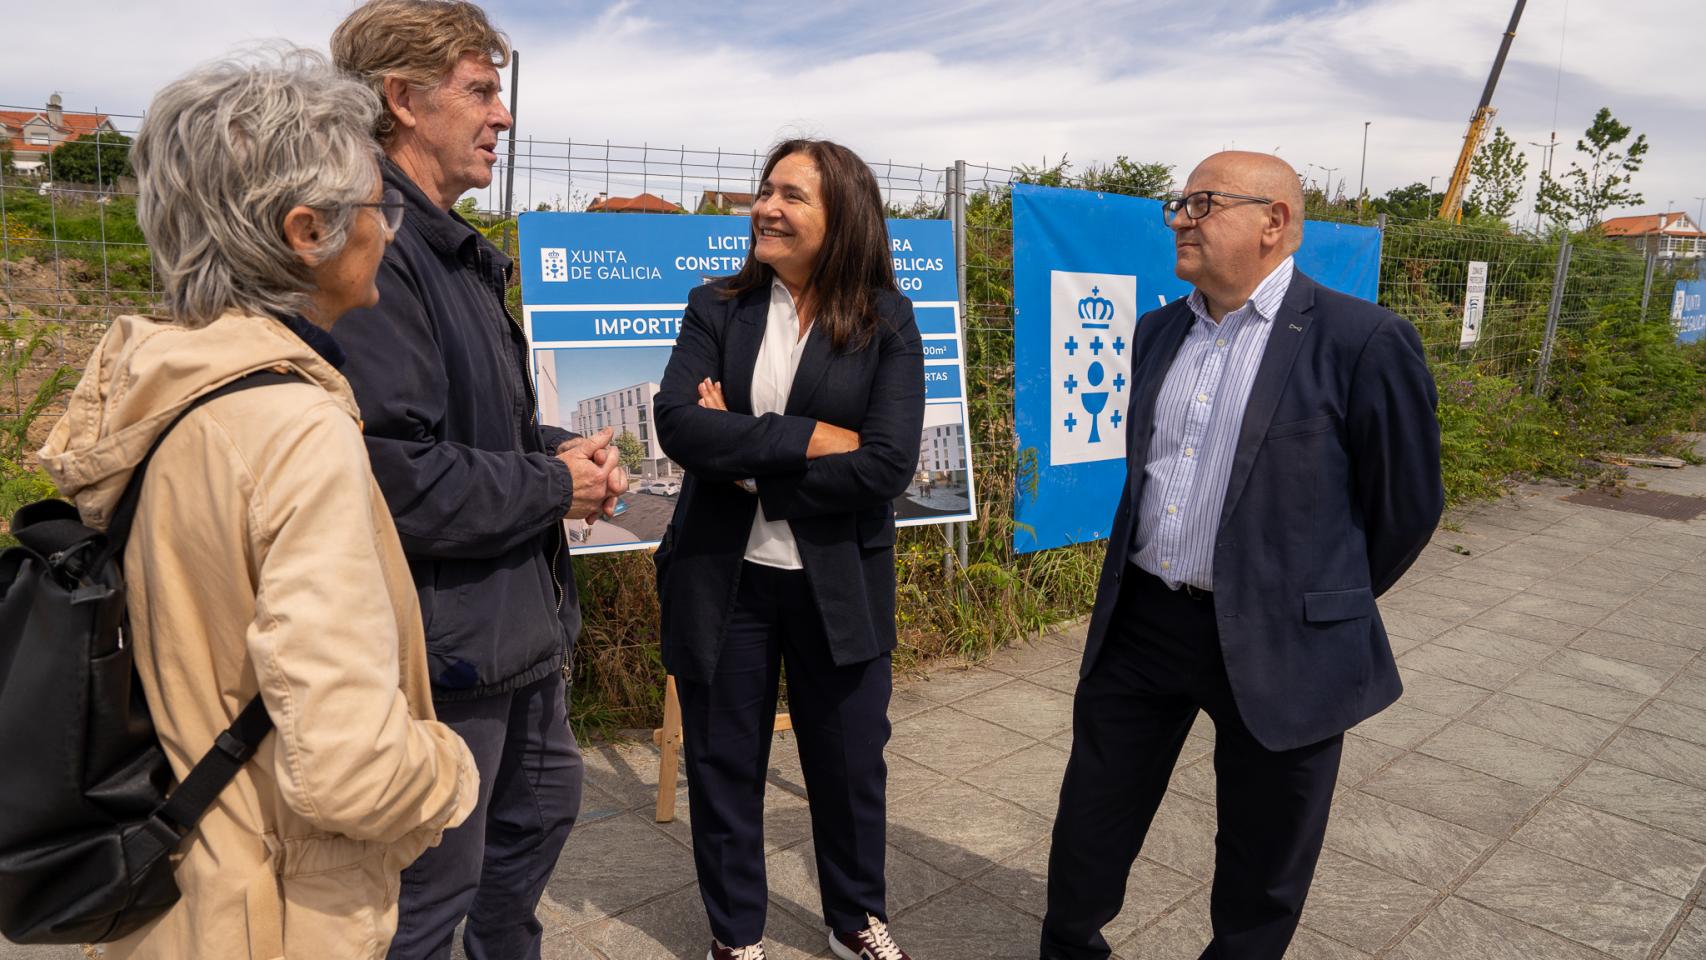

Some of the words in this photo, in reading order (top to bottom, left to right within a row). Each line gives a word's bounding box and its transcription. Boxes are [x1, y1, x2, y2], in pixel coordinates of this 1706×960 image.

[708, 236, 751, 250] LICIT
[892, 238, 912, 251] RA
[571, 250, 627, 263] XUNTA
[893, 257, 944, 271] BLICAS
[571, 266, 592, 280] DE
[597, 266, 662, 280] GALICIA
[924, 371, 948, 381] RTAS
